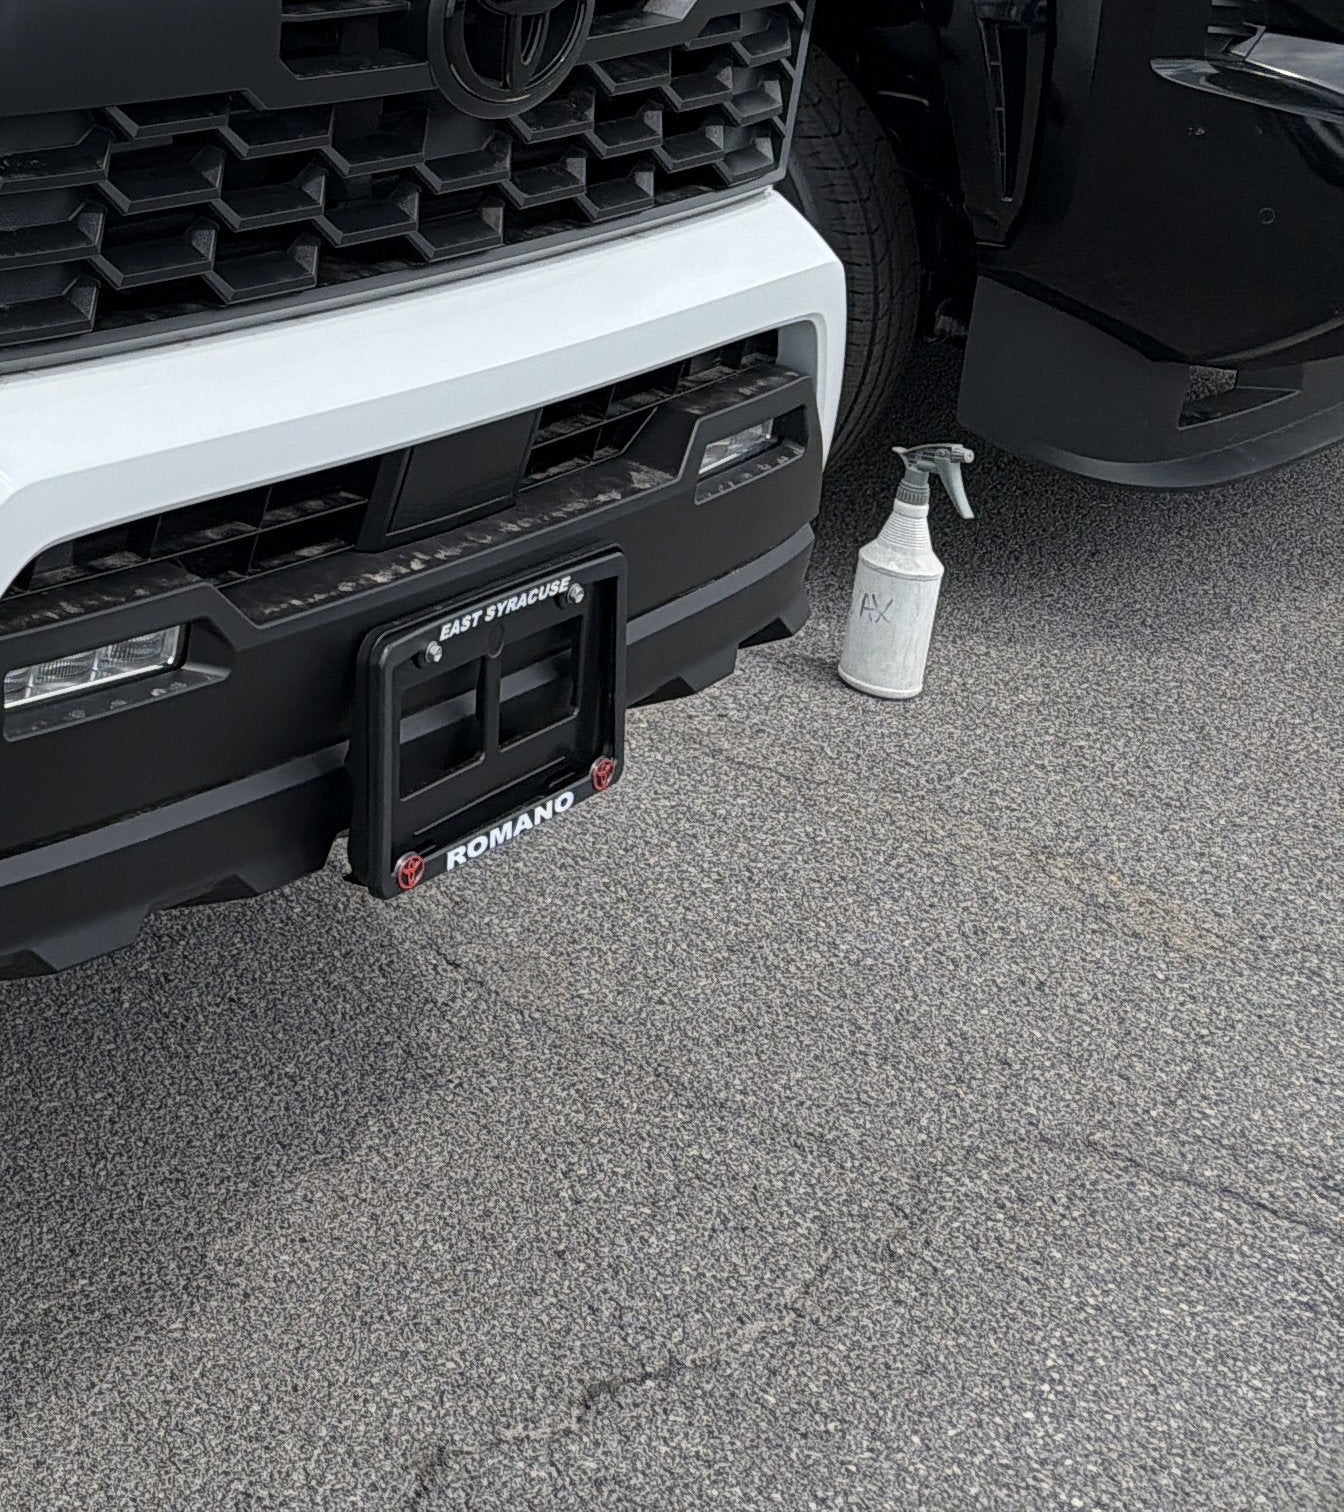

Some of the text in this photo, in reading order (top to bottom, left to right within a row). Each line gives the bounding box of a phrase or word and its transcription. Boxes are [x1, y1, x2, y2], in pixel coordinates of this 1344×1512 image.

[439, 576, 572, 642] EAST SYRACUSE
[446, 791, 577, 871] ROMANO
